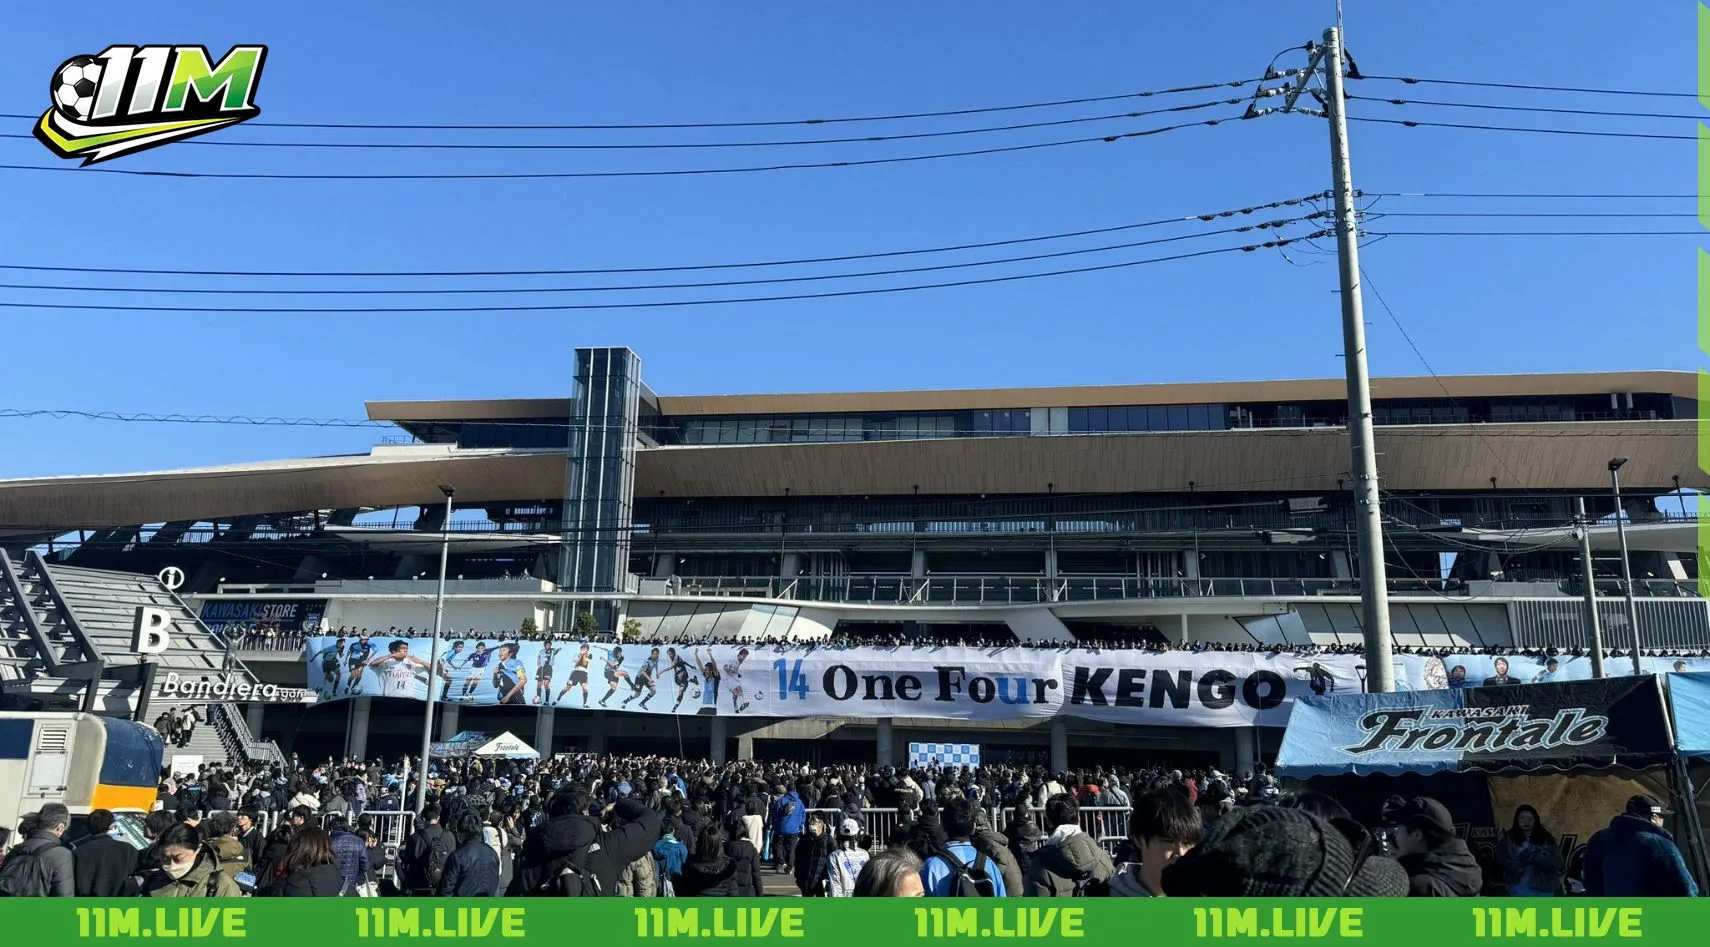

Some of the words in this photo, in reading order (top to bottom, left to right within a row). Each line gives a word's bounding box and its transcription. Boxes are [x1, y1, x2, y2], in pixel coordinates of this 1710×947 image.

[201, 603, 263, 619] KAWASAKI
[263, 603, 298, 618] STORE
[136, 606, 172, 653] B
[163, 672, 278, 697] Bandiera
[396, 680, 406, 690] 14
[773, 657, 810, 700] 14
[822, 664, 922, 700] One
[932, 666, 1058, 704] Four
[1071, 666, 1286, 710] KENGO
[1431, 704, 1530, 719] KAWASAKI
[1334, 705, 1609, 756] Frontale
